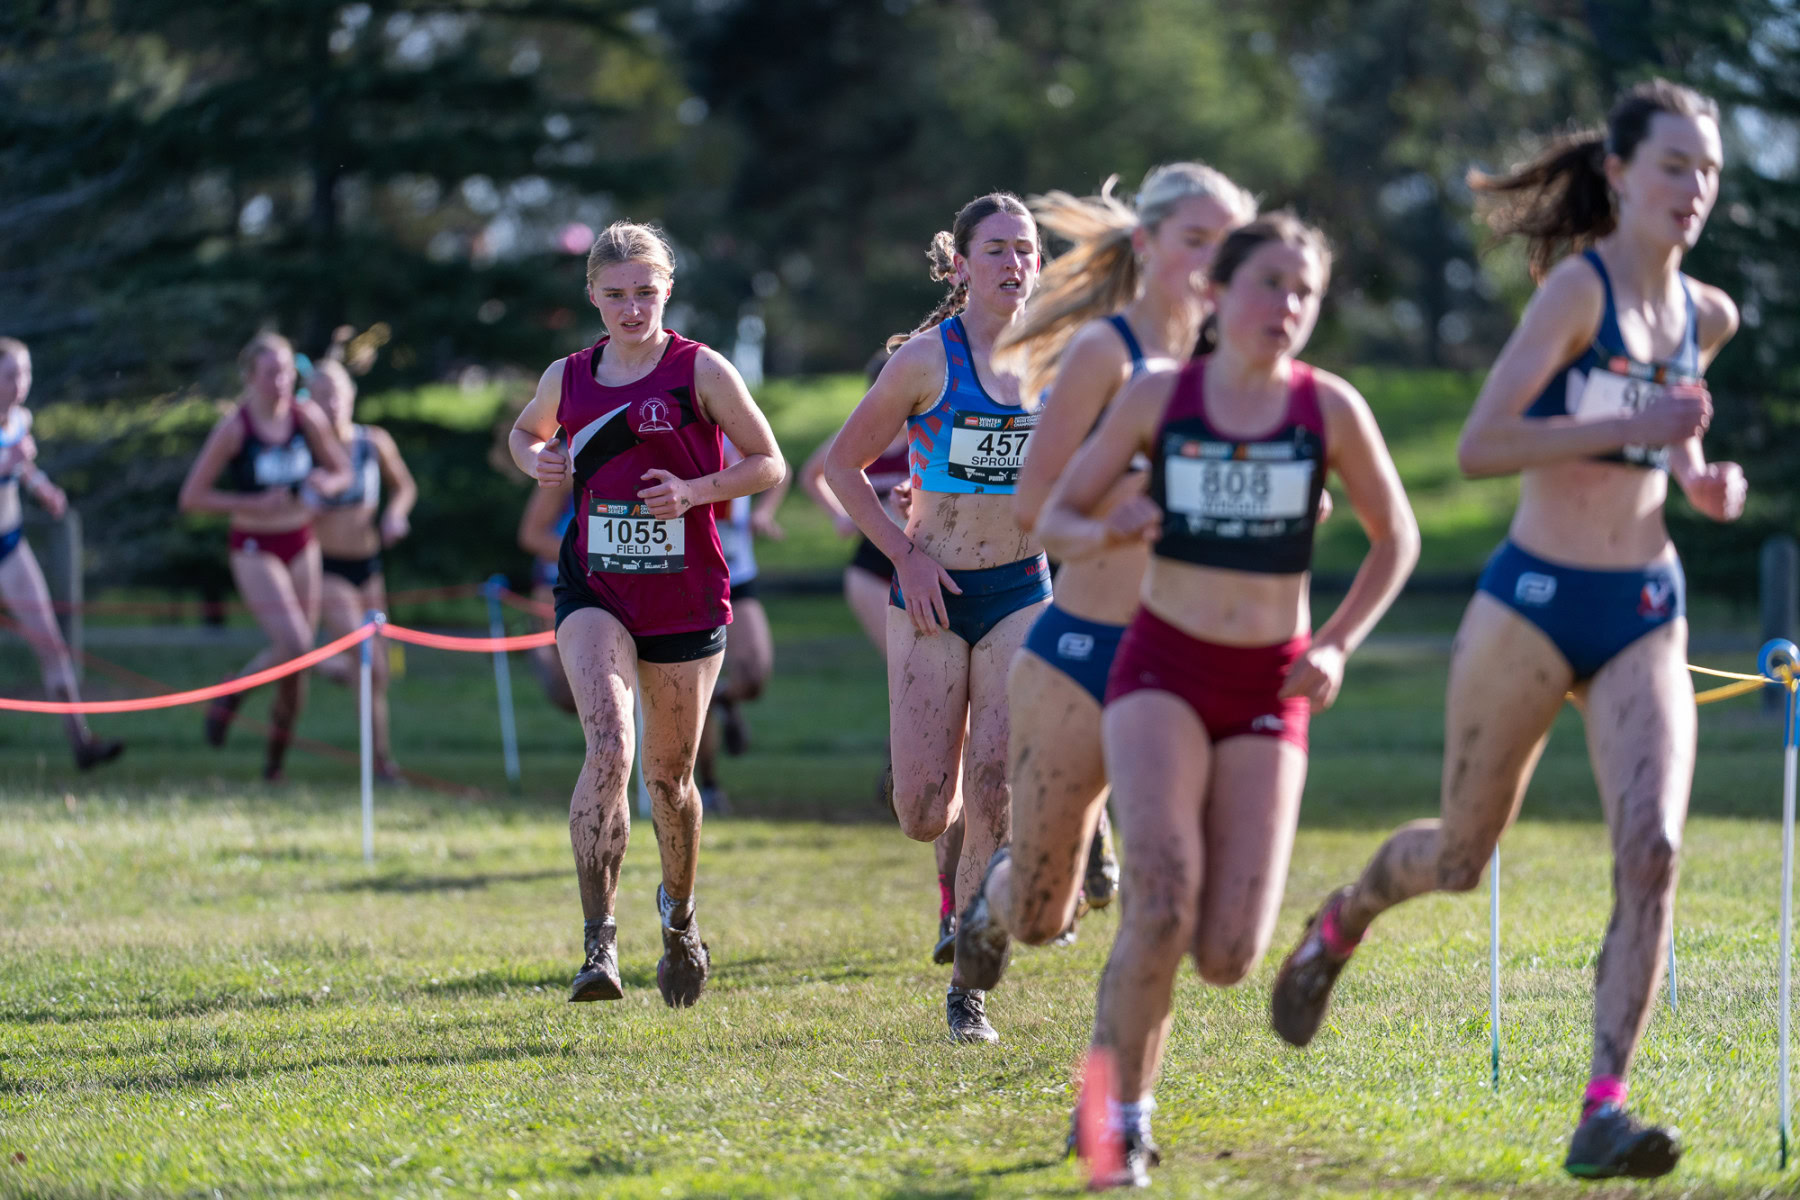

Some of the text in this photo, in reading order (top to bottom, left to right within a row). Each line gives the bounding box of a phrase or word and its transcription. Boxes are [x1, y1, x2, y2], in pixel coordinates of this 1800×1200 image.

[979, 416, 1002, 424] WINTER
[977, 432, 1030, 456] 457
[971, 455, 1030, 467] SPROUL
[1202, 461, 1271, 502] 808
[603, 519, 668, 544] 1055
[616, 545, 651, 555] FIELD
